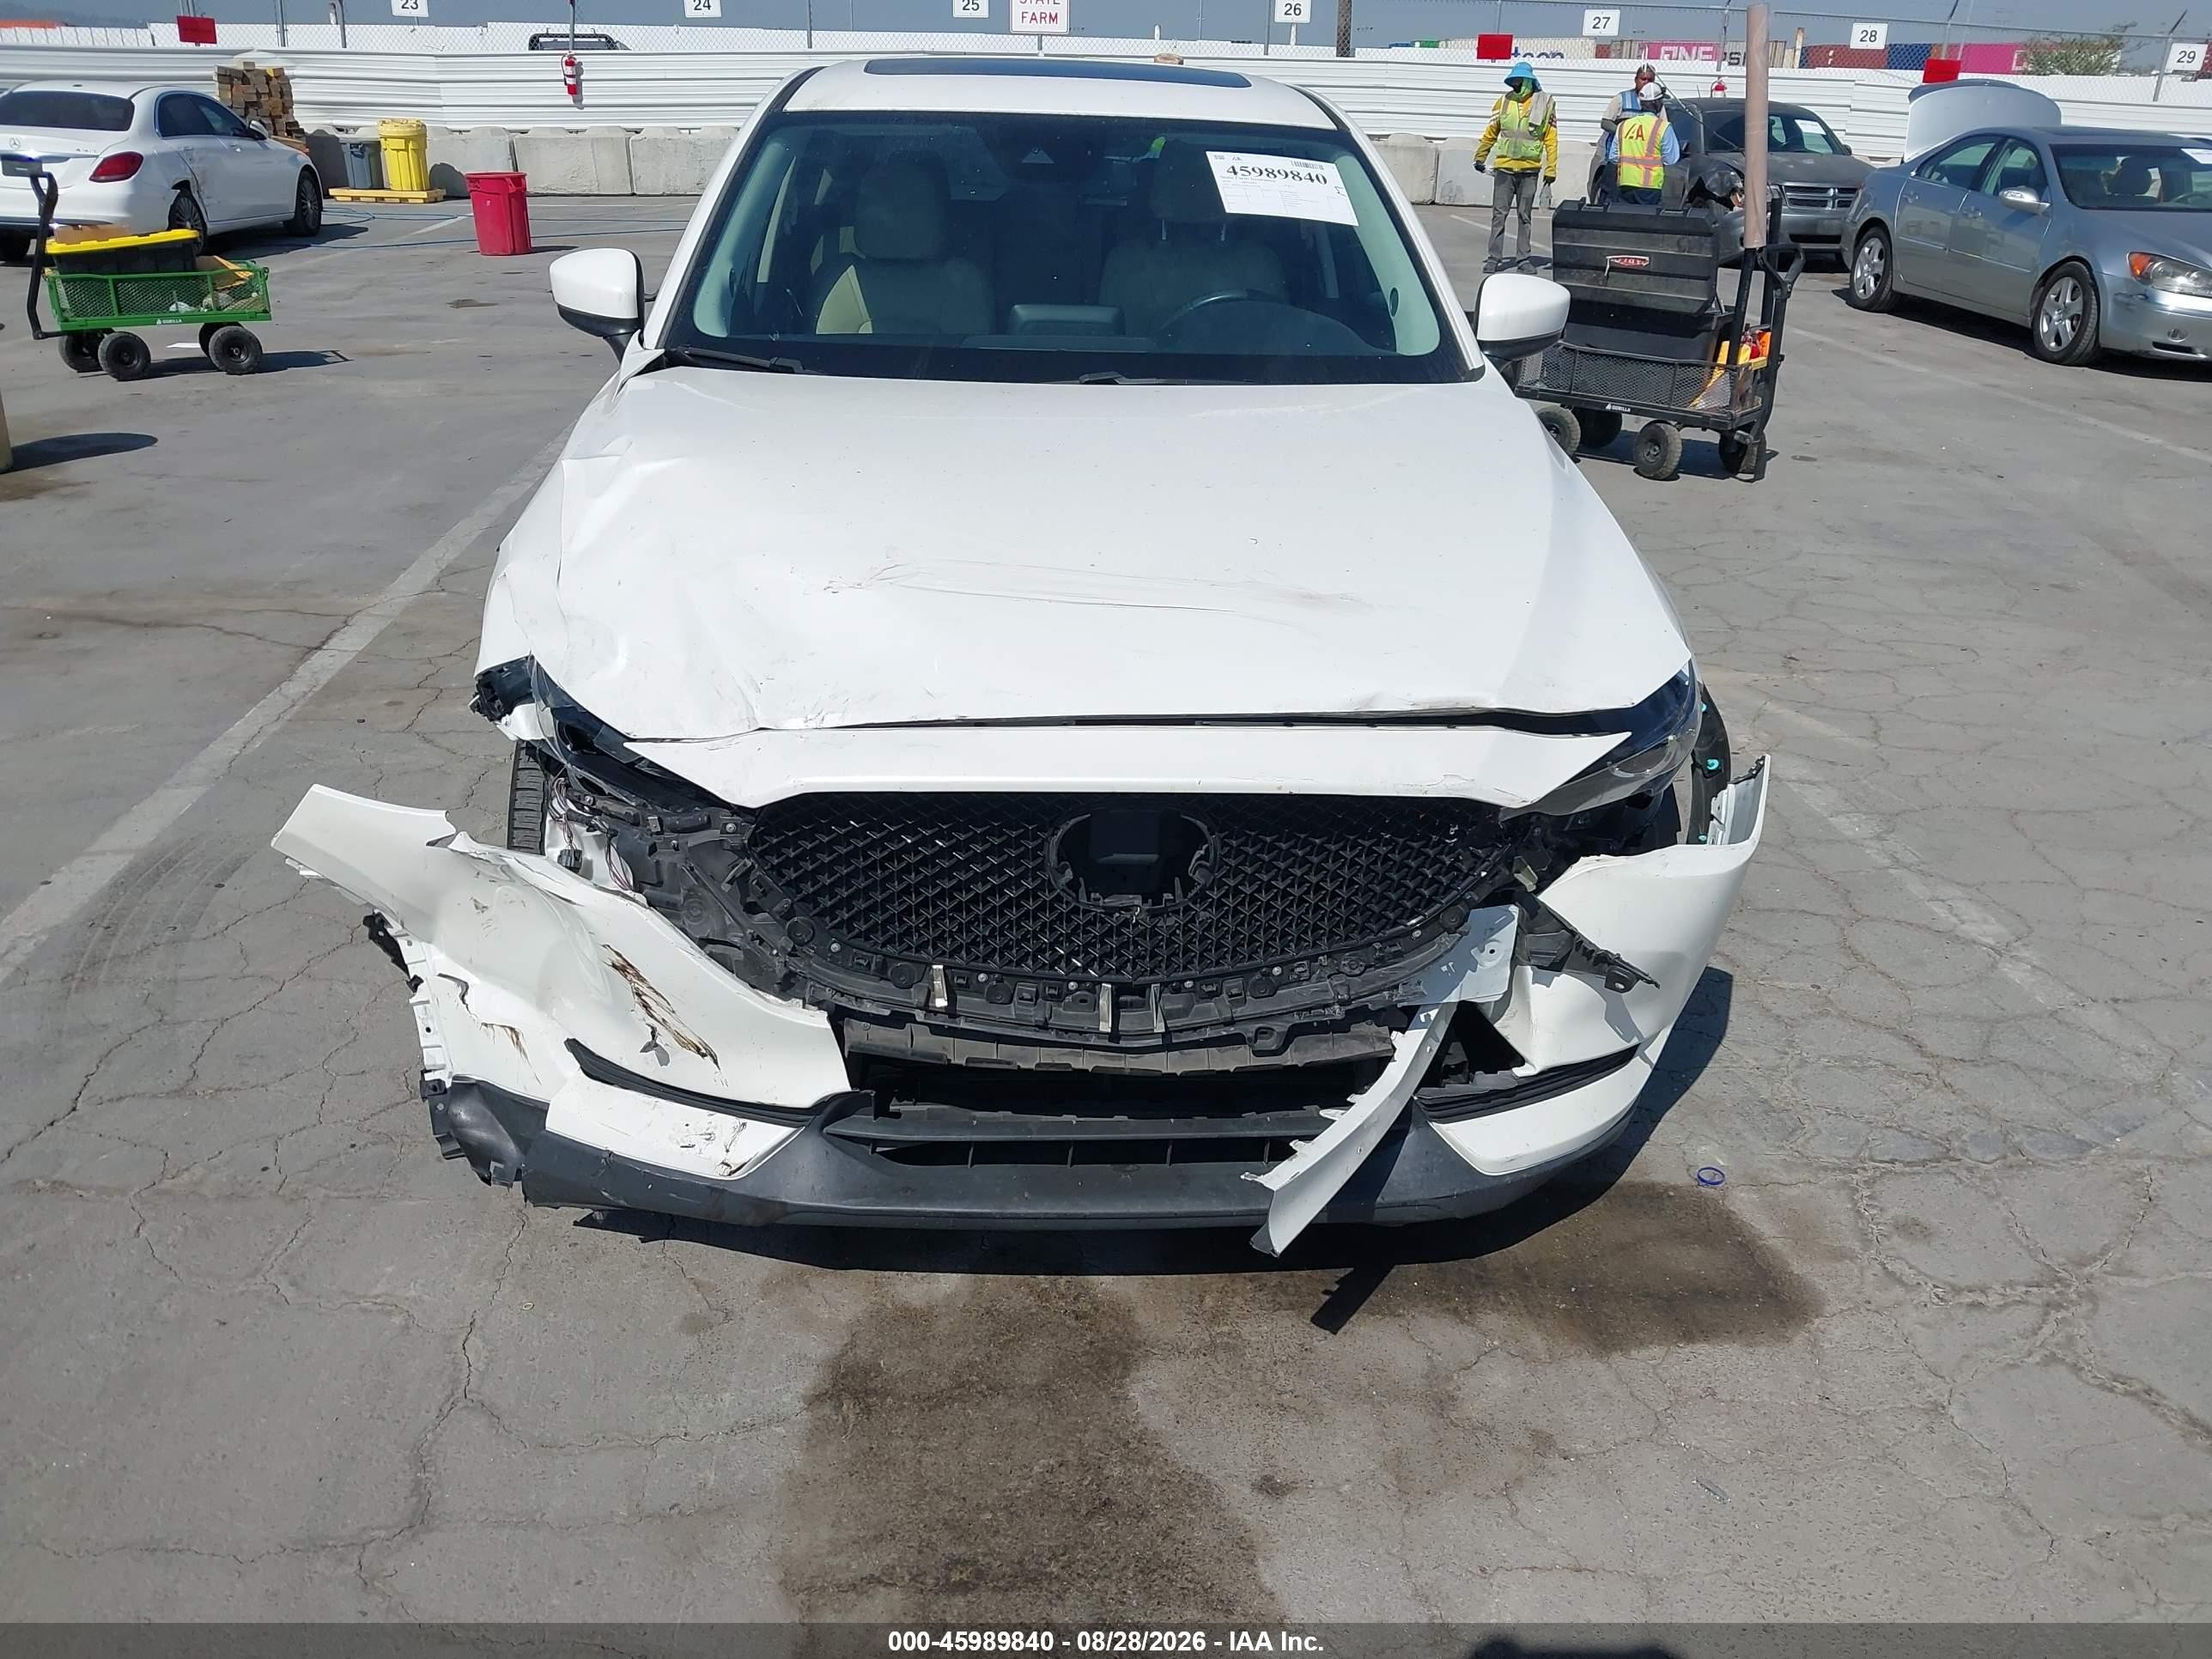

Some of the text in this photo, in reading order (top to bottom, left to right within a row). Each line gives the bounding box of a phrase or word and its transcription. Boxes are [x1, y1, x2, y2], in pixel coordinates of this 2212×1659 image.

[401, 0, 418, 9] 23
[693, 0, 711, 10] 24
[962, 0, 980, 11] 25
[1284, 3, 1302, 16] 26
[1021, 11, 1058, 25] FARM
[1592, 16, 1611, 29] 27
[1859, 29, 1878, 43] 28
[2177, 50, 2197, 64] 29
[1226, 165, 1328, 185] 45989840
